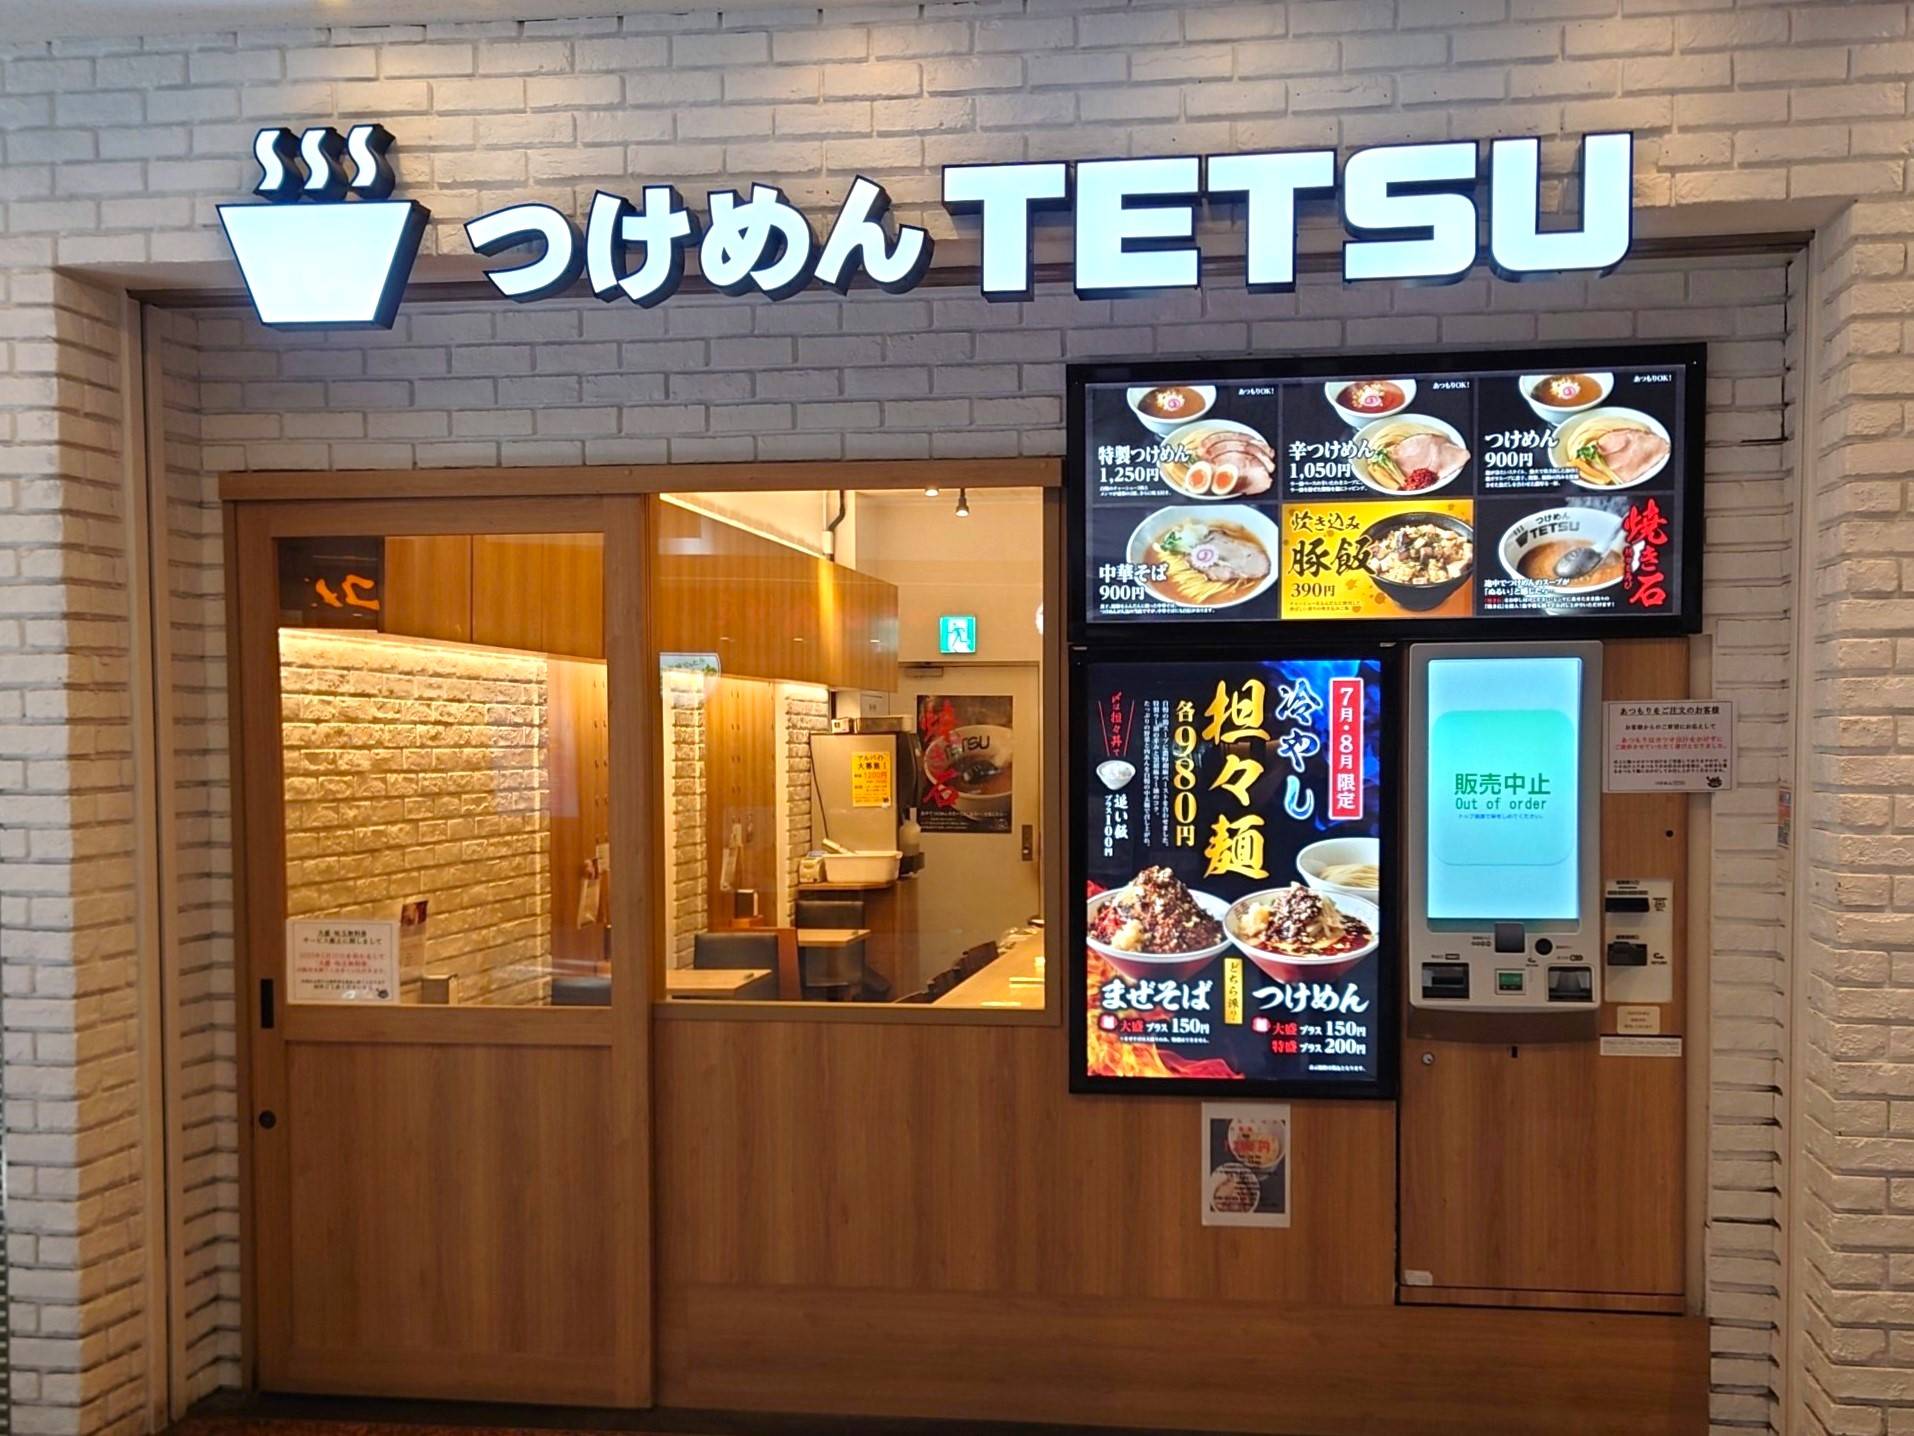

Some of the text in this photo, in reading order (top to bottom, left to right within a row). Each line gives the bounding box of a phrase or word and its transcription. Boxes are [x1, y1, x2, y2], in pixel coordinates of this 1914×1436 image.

[464, 131, 1633, 307] つけめん TETSU
[1484, 429, 1560, 449] つけめん
[1098, 445, 1189, 465] 特製つけめん
[1288, 441, 1375, 461] 辛つけめん
[1484, 452, 1534, 467] 900円
[1099, 467, 1160, 484] 1,250円
[1289, 462, 1351, 480] 1,050円
[1290, 511, 1361, 533] 炊き込み
[1529, 521, 1580, 539] TETSU
[1288, 537, 1376, 578] 豚飯
[1624, 498, 1669, 607] 焼き石
[1099, 563, 1169, 583] 中華そば
[1099, 586, 1146, 601] 900円
[1290, 583, 1336, 598] 390円
[1276, 677, 1323, 820] 冷やし
[1174, 700, 1197, 847] 各980円
[1201, 679, 1271, 880] 担々麺
[1454, 772, 1551, 796] 販売中止
[1456, 797, 1547, 810] Out of order
[1114, 794, 1128, 839] 追い飯
[1101, 978, 1213, 1011] まぜそば
[1252, 982, 1370, 1014] つけめん
[1120, 1020, 1143, 1033] 大盛
[1146, 1022, 1168, 1033] プラス
[1171, 1018, 1210, 1035] 150円
[1272, 1023, 1297, 1036] 大盛
[1300, 1025, 1323, 1036] プラス
[1325, 1020, 1366, 1037] 150円
[1300, 1043, 1323, 1053] プラス
[1325, 1038, 1366, 1055] 200円
